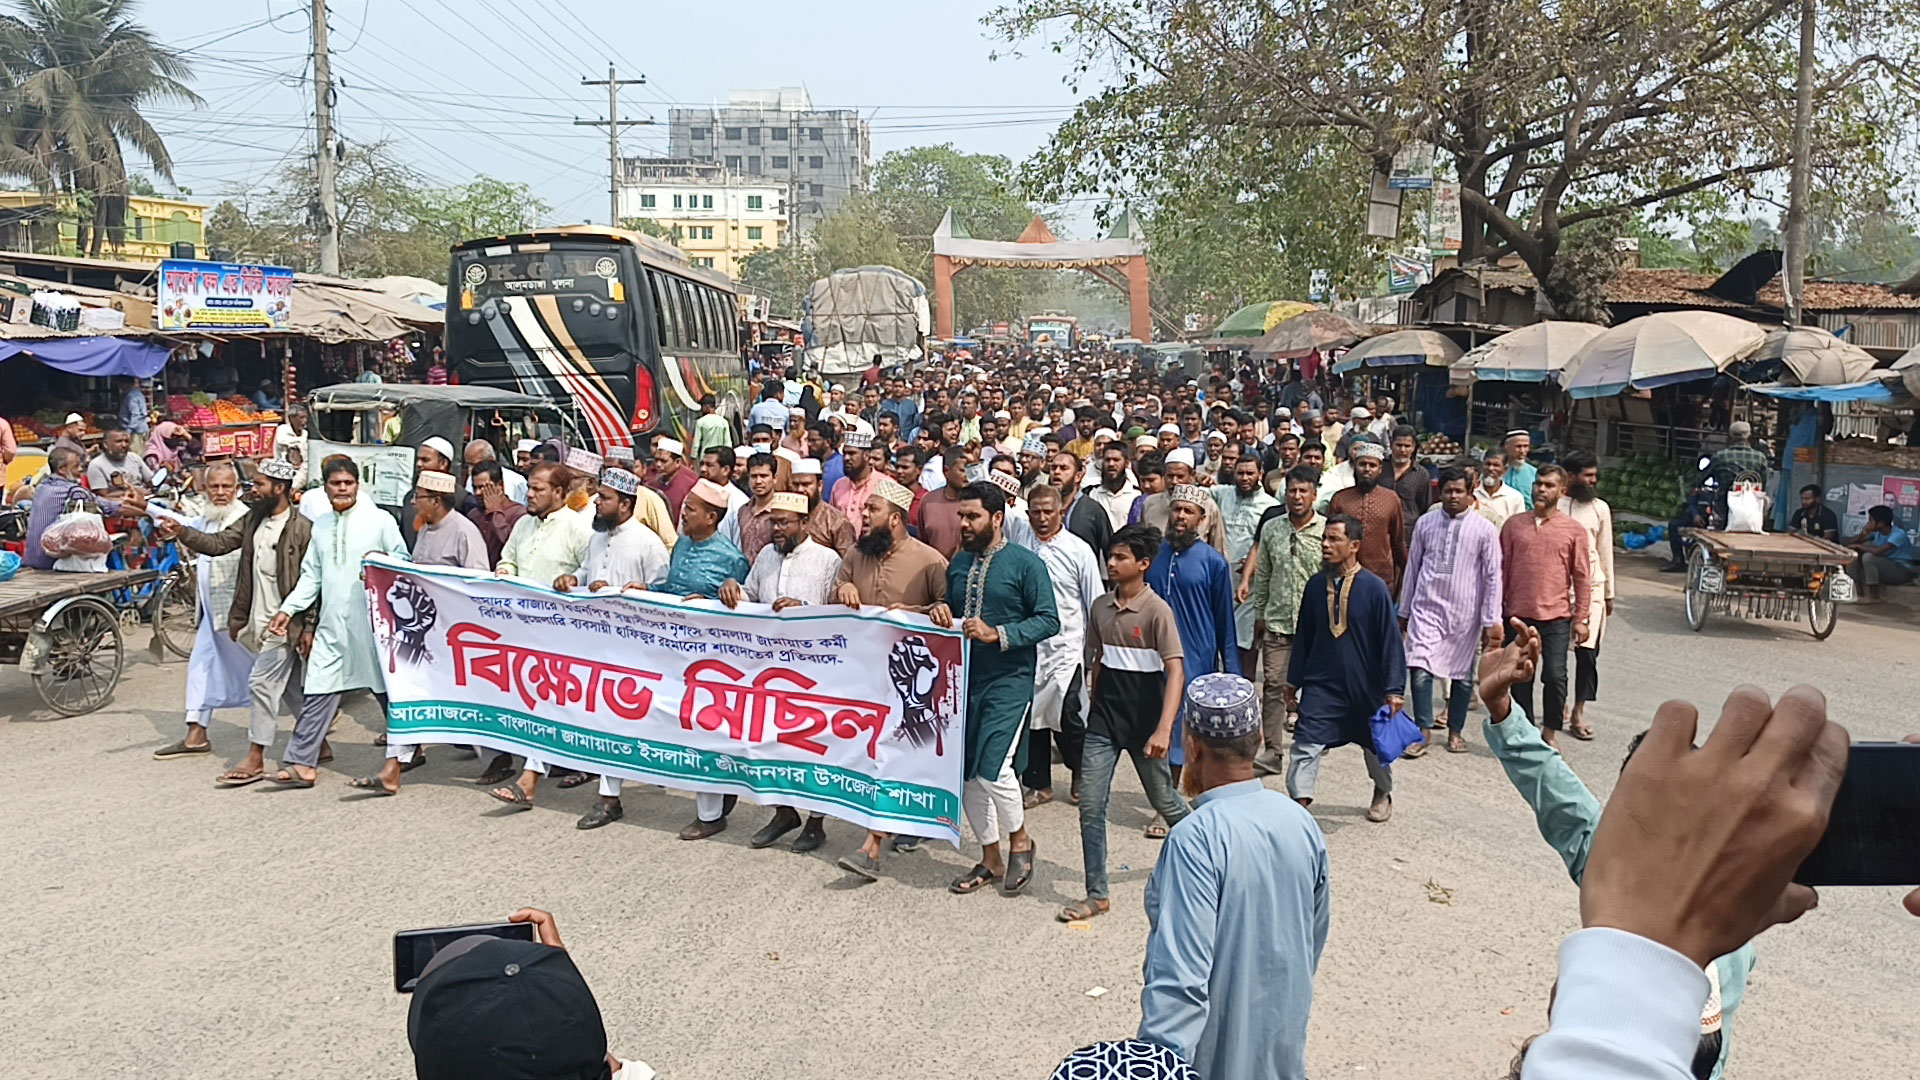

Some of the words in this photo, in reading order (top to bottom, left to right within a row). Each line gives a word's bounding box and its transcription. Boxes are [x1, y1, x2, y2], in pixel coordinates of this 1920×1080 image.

[552, 279, 574, 290] খুলনা
[479, 606, 513, 621] বিশিষ্ট
[570, 616, 612, 636] ব্যবসায়ী
[615, 626, 656, 645] হাফিজুর
[658, 635, 706, 654] রহমানের
[711, 642, 773, 659] শাহাদতের
[517, 596, 557, 612] বাজারে
[670, 622, 701, 638] নৃশংস
[708, 627, 752, 643] হামলায়
[756, 634, 813, 649] জামায়াত
[817, 633, 848, 649] কর্মী
[446, 621, 663, 720] বিক্ষোভ
[678, 658, 891, 760] মিছিল
[497, 712, 556, 741] বাংলাদেশ
[561, 729, 633, 756] জামায়াতে
[714, 754, 806, 784] জীবননগর
[812, 765, 881, 802] উপজেলা
